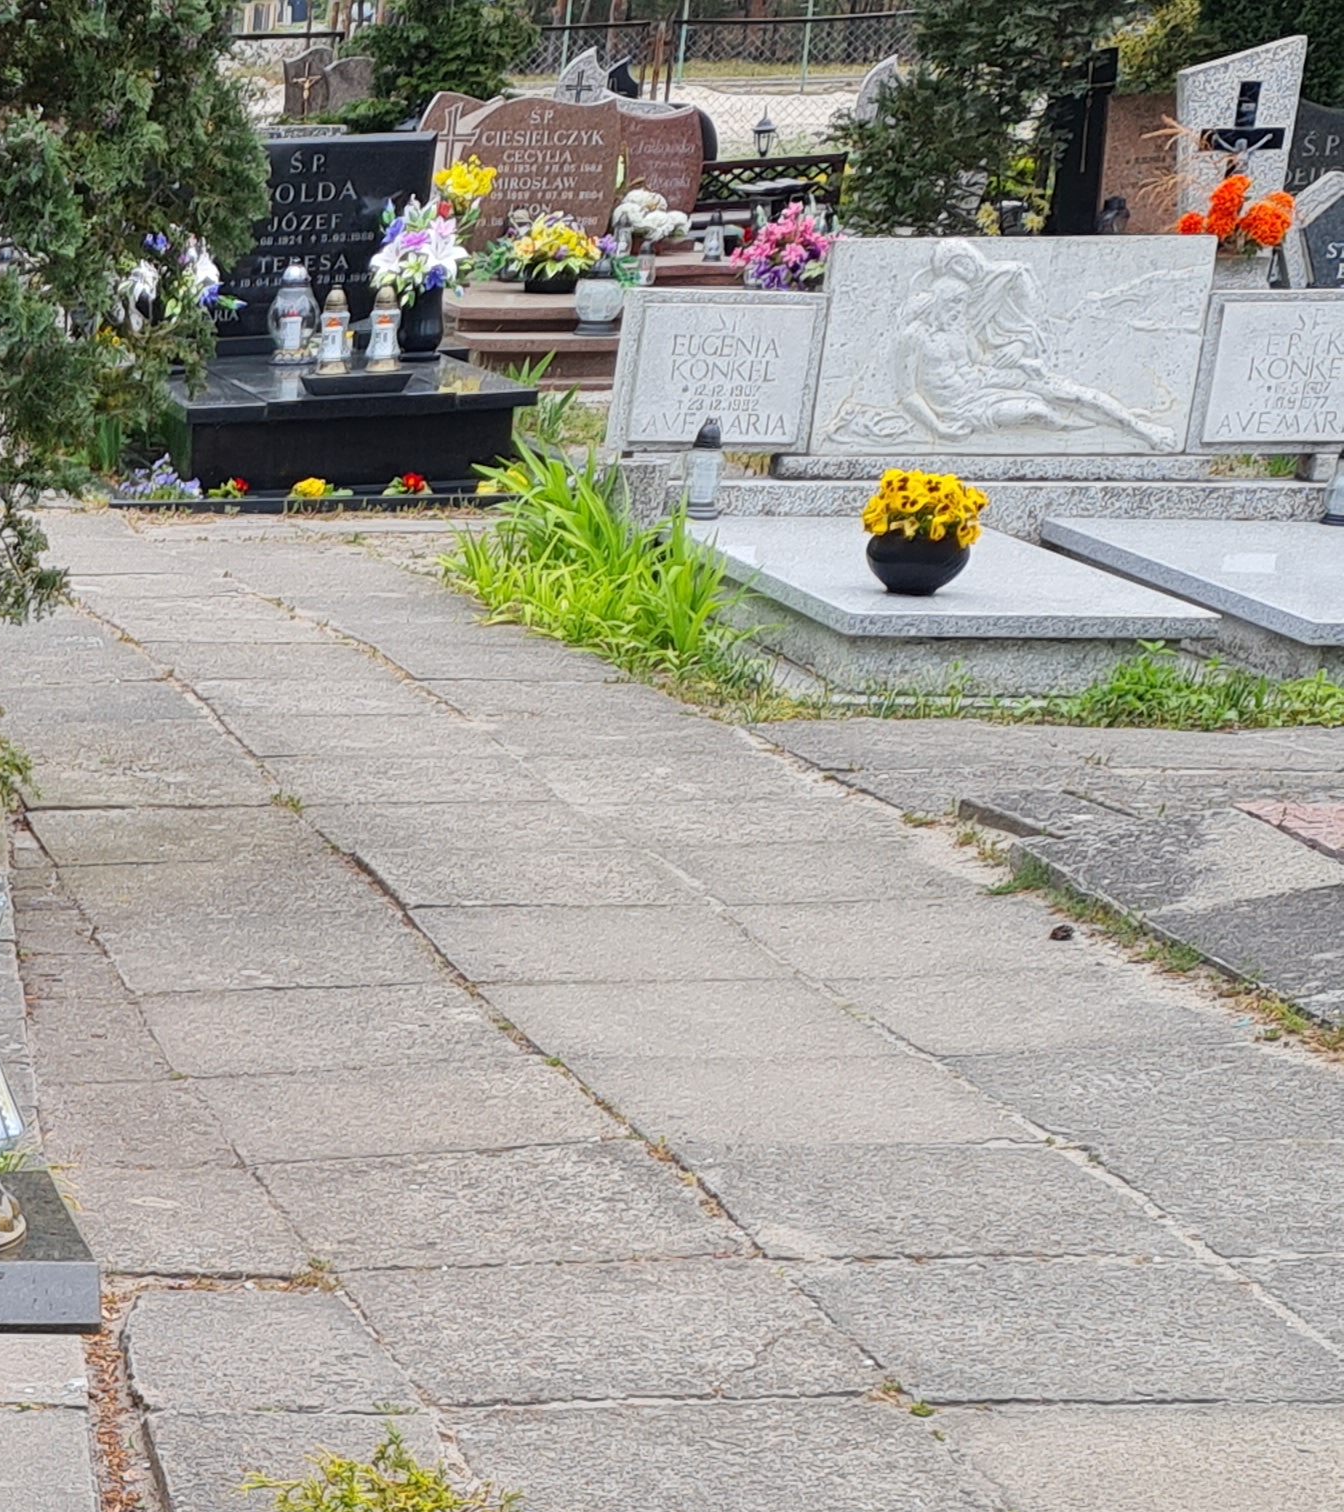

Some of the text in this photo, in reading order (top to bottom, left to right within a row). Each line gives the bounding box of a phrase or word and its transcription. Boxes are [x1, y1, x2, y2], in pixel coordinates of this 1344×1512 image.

[481, 129, 605, 147] CIESIELCZYK
[274, 180, 358, 204] OLDA
[492, 176, 579, 190] MIROSŁAW
[267, 211, 343, 232] JÓZEF
[671, 333, 780, 359] EUGENIA
[671, 358, 777, 383] KONKEL
[1247, 356, 1342, 382] KONKE
